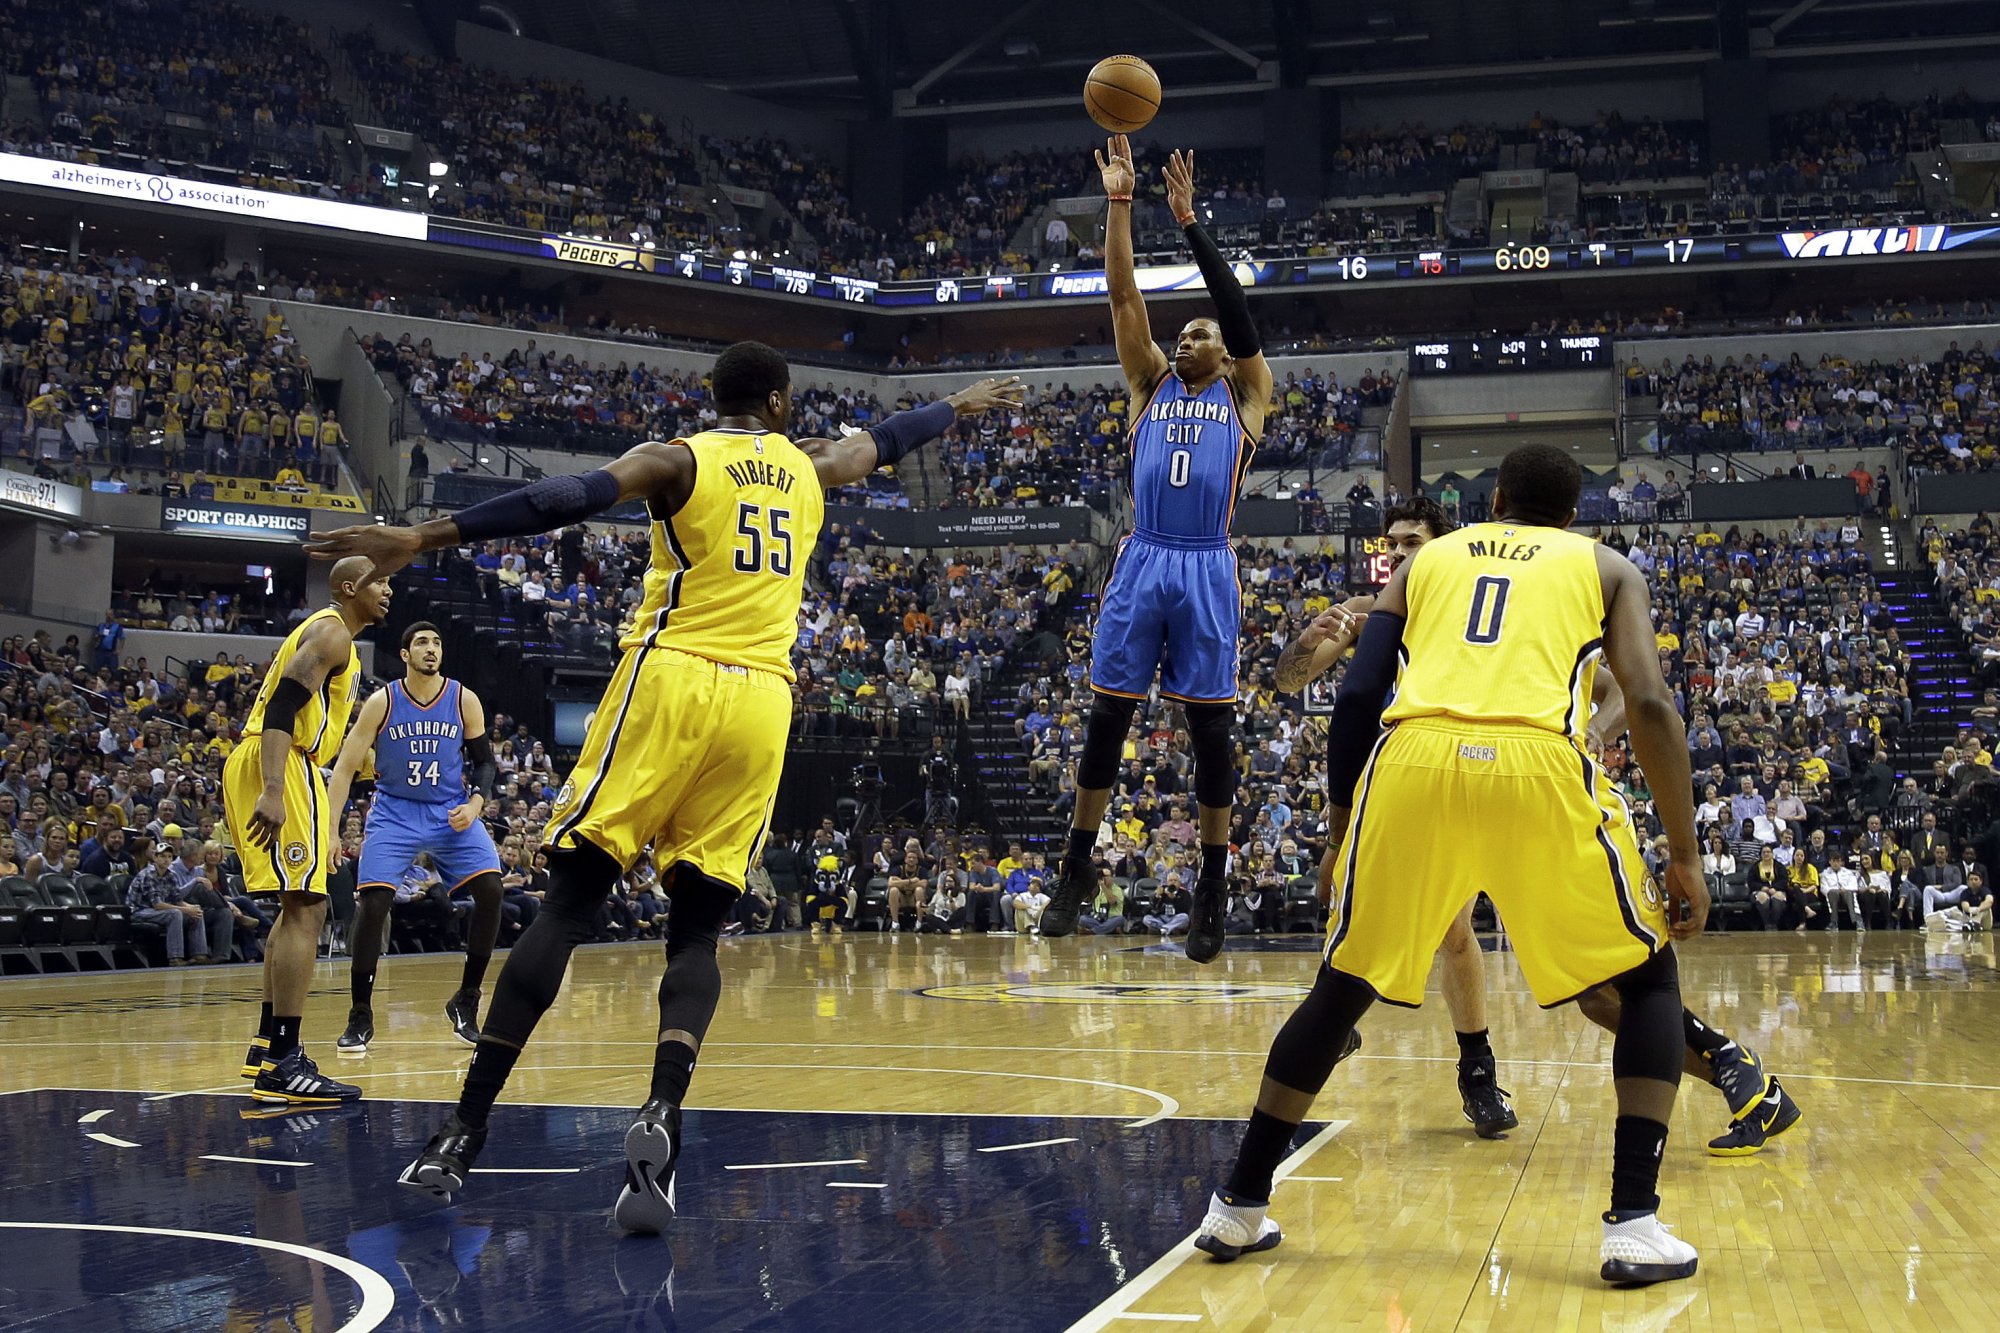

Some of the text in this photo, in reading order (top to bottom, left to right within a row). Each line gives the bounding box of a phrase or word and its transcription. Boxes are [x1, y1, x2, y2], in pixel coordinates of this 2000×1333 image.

[52, 168, 266, 209] alzheimer's association
[558, 242, 619, 265] Pacers
[1495, 246, 1550, 270] 6:09
[1664, 239, 1694, 262] 17
[682, 263, 693, 277] 4
[731, 270, 742, 285] 3
[1338, 256, 1367, 280] 16
[1420, 260, 1442, 274] 15
[785, 277, 808, 294] 7/9
[843, 285, 865, 303] 1/2
[936, 286, 958, 302] 6/1
[1415, 344, 1449, 355] PACERS
[1560, 337, 1600, 349] THUNDER
[1582, 350, 1592, 361] 17
[1150, 399, 1229, 425] OKLAHOMA
[1166, 423, 1203, 444] CITY
[725, 459, 795, 494] HIBBERT
[1169, 449, 1191, 488] 0
[39, 482, 56, 503] 97.1
[165, 507, 307, 531] SPORT GRAPHICS
[971, 515, 1026, 525] NEED HELP?
[734, 501, 792, 577] 55
[1467, 540, 1542, 561] MILES
[1370, 555, 1391, 583] 15
[1463, 573, 1511, 647] 0
[388, 720, 458, 741] OKLAHOMA
[410, 739, 439, 754] CITY
[407, 761, 440, 786] 34
